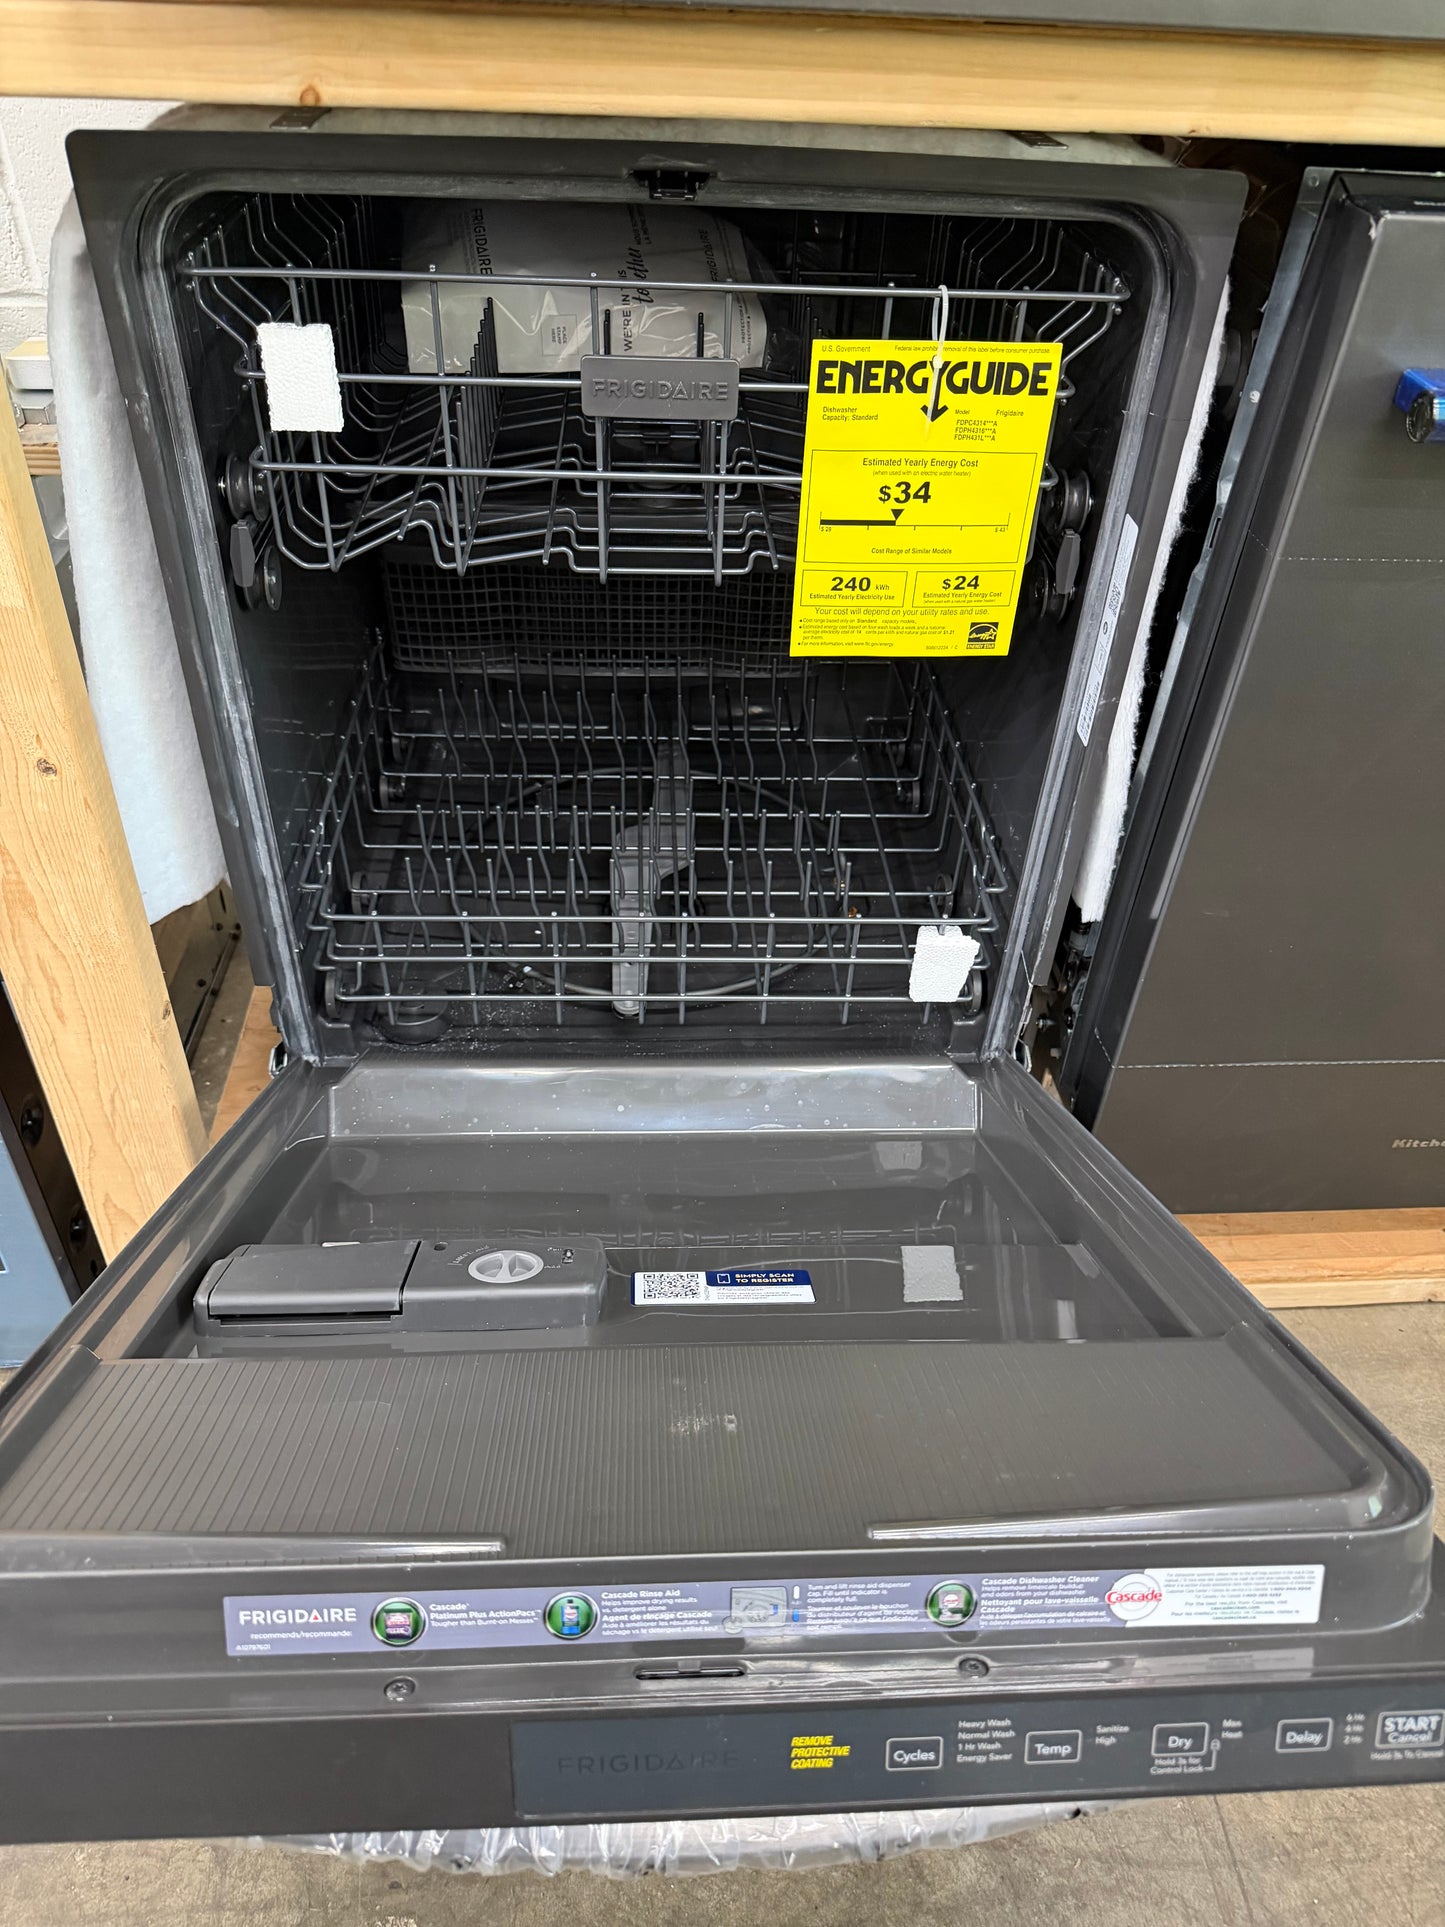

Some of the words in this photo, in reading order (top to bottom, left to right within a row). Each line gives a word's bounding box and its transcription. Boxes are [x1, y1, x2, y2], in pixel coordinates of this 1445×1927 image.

[473, 208, 493, 275] FRIGIDAIRE
[698, 228, 718, 283] FRIGIDAIRE
[625, 247, 654, 304] toether
[621, 294, 631, 306] IN
[622, 309, 633, 352] WE'RE
[822, 344, 833, 352] U.S.
[836, 344, 871, 352] Government
[816, 360, 1053, 396] ENERGYGUIDE
[592, 378, 728, 400] FRIGIDAIRE
[822, 413, 850, 422] Capacity:
[851, 413, 879, 421] Standard
[995, 409, 1025, 418] Frigidaire
[862, 458, 902, 467] Estimated
[904, 458, 929, 469] Yearly
[930, 458, 959, 469] Energy
[959, 459, 979, 467] Cost
[878, 481, 932, 504] $34
[871, 547, 885, 555] Cost
[885, 548, 904, 556] Range
[904, 547, 911, 555] of
[911, 547, 931, 555] Similar
[931, 547, 953, 555] Models
[830, 576, 871, 592] 240
[875, 583, 890, 591] kWh
[942, 575, 980, 591] $24
[809, 592, 837, 600] Estimated
[838, 593, 855, 601] Yearly
[855, 593, 883, 601] Electricity
[969, 591, 988, 599] Energy
[815, 607, 832, 615] Your
[833, 607, 849, 615] cost
[850, 607, 862, 615] will
[863, 608, 890, 617] depend
[891, 608, 901, 616] on
[902, 609, 919, 617] your
[919, 608, 939, 617] utility
[939, 608, 958, 616] rates
[959, 608, 974, 616] and
[1018, 1576, 1067, 1584] Dishwasher
[1067, 1575, 1100, 1583] Cleaner
[601, 1591, 638, 1599] Cascade
[639, 1590, 664, 1598] Rinse
[664, 1589, 681, 1597] Aid
[834, 1589, 850, 1597] until
[1106, 1589, 1163, 1606] Cascade
[601, 1599, 622, 1607] Helps
[980, 1598, 1022, 1607] Nettoyant
[1022, 1599, 1044, 1607] pour
[1044, 1595, 1100, 1604] lave-vaisselle
[238, 1607, 358, 1626] FRIGIDAIRE
[430, 1611, 468, 1620] Platinum
[469, 1611, 488, 1619] Plus
[602, 1614, 629, 1622] Agent
[630, 1613, 642, 1621] de
[643, 1612, 676, 1621] rinçage
[676, 1611, 714, 1619] Cascade
[430, 1620, 459, 1628] Tougher
[958, 1719, 986, 1729] Heavy
[987, 1717, 1012, 1727] Wash
[1095, 1724, 1130, 1734] Sanitize
[1383, 1714, 1442, 1733] START
[957, 1729, 991, 1740] Normal
[991, 1728, 1016, 1738] Wash
[1221, 1730, 1244, 1739] Heat
[1285, 1730, 1324, 1746] Delay
[1387, 1730, 1434, 1744] Cancel
[791, 1735, 834, 1747] REMOVE
[957, 1742, 963, 1751] 1
[964, 1742, 976, 1751] Hr
[977, 1740, 1002, 1750] Wash
[1095, 1736, 1117, 1746] High
[1167, 1735, 1194, 1751] Dry
[790, 1745, 851, 1758] PROTECTIVE
[893, 1748, 936, 1764] Cycles
[1034, 1743, 1073, 1758] Temp
[558, 1750, 740, 1775] FRIGIDAIRE
[791, 1757, 834, 1770] COATING
[956, 1753, 988, 1764] Energy
[988, 1752, 1013, 1762] Saver
[1150, 1765, 1183, 1775] Control
[1183, 1764, 1204, 1773] Lock
